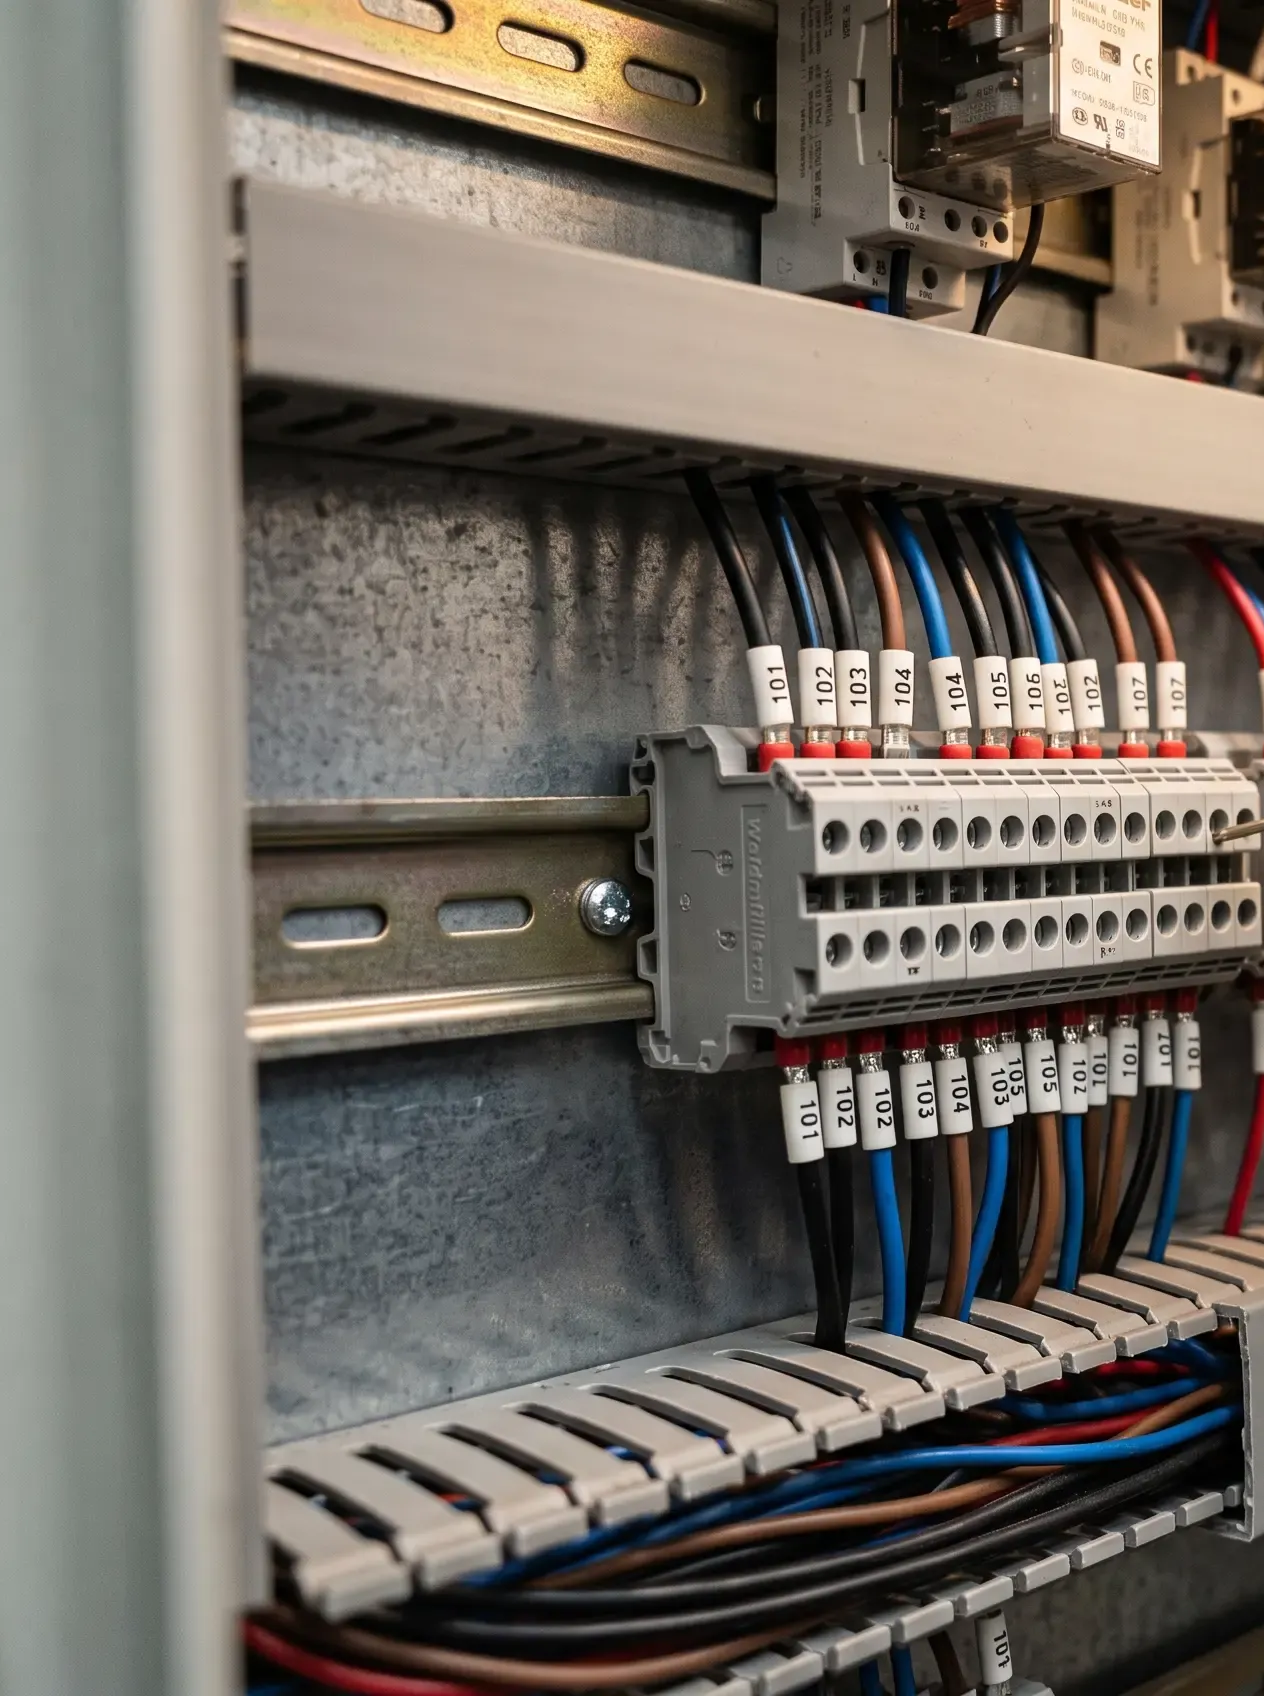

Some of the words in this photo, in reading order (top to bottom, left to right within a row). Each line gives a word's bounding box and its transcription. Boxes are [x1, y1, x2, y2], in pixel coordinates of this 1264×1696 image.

[1133, 53, 1153, 79] CE
[767, 666, 788, 703] 101
[816, 666, 833, 706] 102
[850, 667, 867, 707] 103
[895, 668, 912, 706] 104
[945, 672, 967, 711] 104
[991, 672, 1009, 710] 105
[1026, 673, 1042, 711] 106
[1084, 675, 1101, 711] 102
[1132, 676, 1148, 712] 107
[1170, 677, 1186, 712] 107
[990, 1068, 1010, 1106] 103
[1008, 1057, 1025, 1096] 105
[1040, 1055, 1058, 1093] 105
[836, 1085, 854, 1128] 102
[875, 1087, 893, 1129] 102
[916, 1079, 935, 1119] 103
[951, 1074, 970, 1113] 104
[800, 1099, 819, 1139] 101
